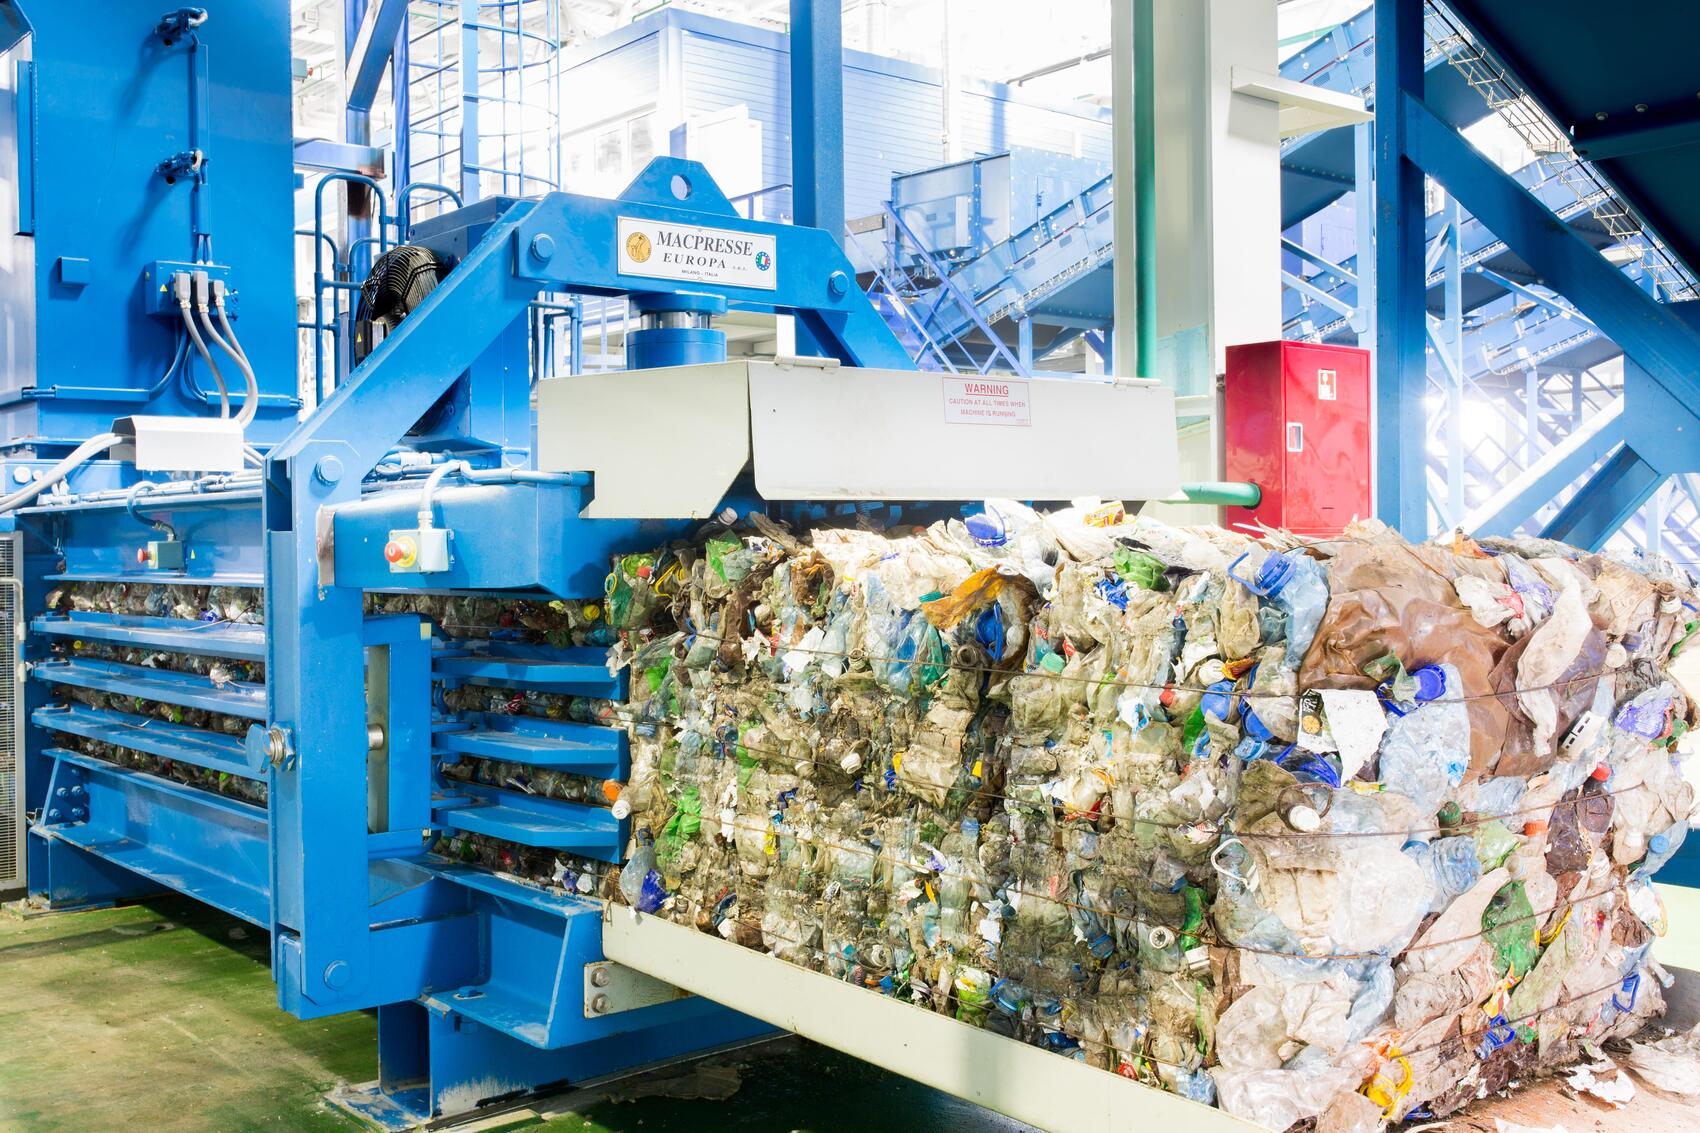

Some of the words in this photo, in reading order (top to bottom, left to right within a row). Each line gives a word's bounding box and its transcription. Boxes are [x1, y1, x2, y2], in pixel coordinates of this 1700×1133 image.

[656, 230, 753, 257] MACPRESSE
[663, 252, 726, 269] EUROPA
[965, 383, 1009, 395] WARNING
